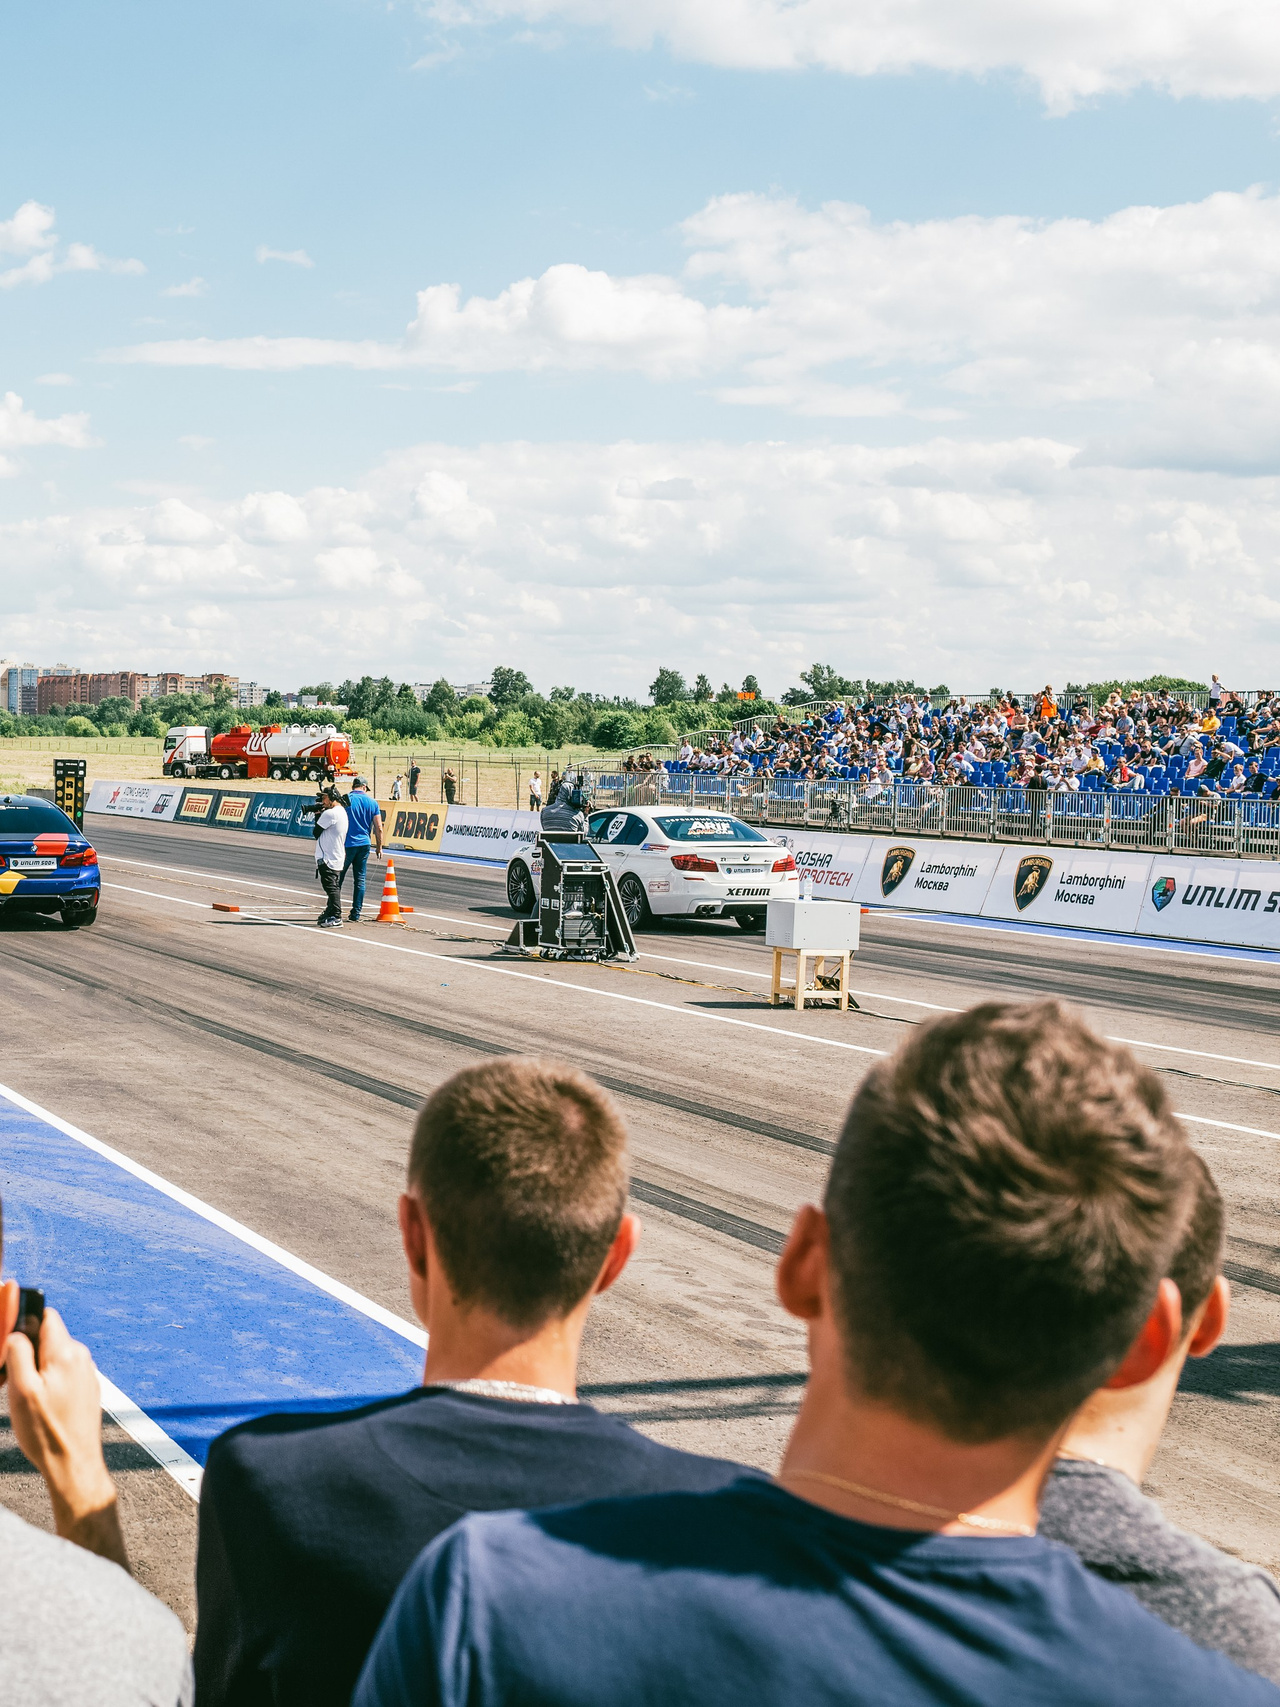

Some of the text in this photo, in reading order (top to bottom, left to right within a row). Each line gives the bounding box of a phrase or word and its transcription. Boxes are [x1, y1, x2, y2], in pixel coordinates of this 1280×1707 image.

[65, 781, 74, 819] RDR
[184, 798, 210, 814] PIRELLI
[220, 801, 246, 817] PIRELLI
[795, 851, 833, 868] GOSHA
[920, 861, 978, 878] Lamborghini
[914, 877, 950, 891] Москва
[1059, 872, 1126, 890] Lamborghini
[726, 888, 771, 897] XENUM
[1054, 889, 1095, 905] Москва
[1181, 885, 1261, 911] UNLIM
